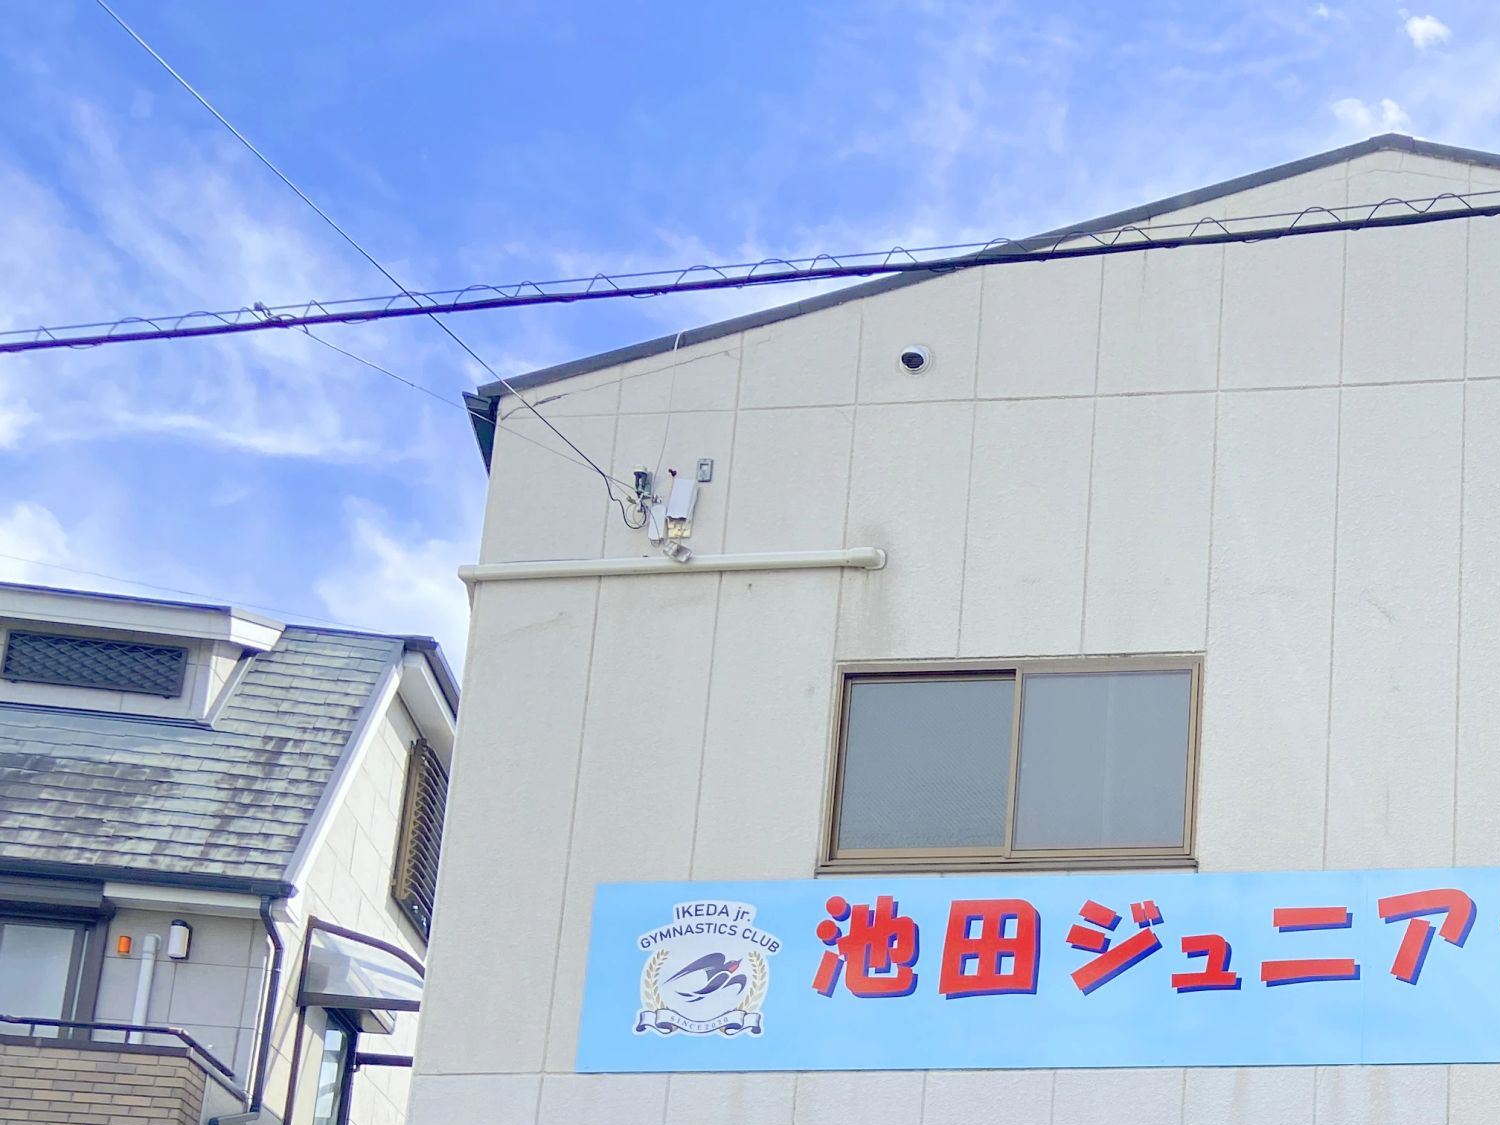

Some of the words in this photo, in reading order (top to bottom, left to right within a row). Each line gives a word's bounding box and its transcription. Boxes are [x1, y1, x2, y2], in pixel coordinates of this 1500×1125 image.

[675, 903, 730, 920] IKEDA
[732, 906, 752, 922] jr.
[640, 922, 738, 949] GYMNASTICS
[741, 928, 780, 953] CLUB
